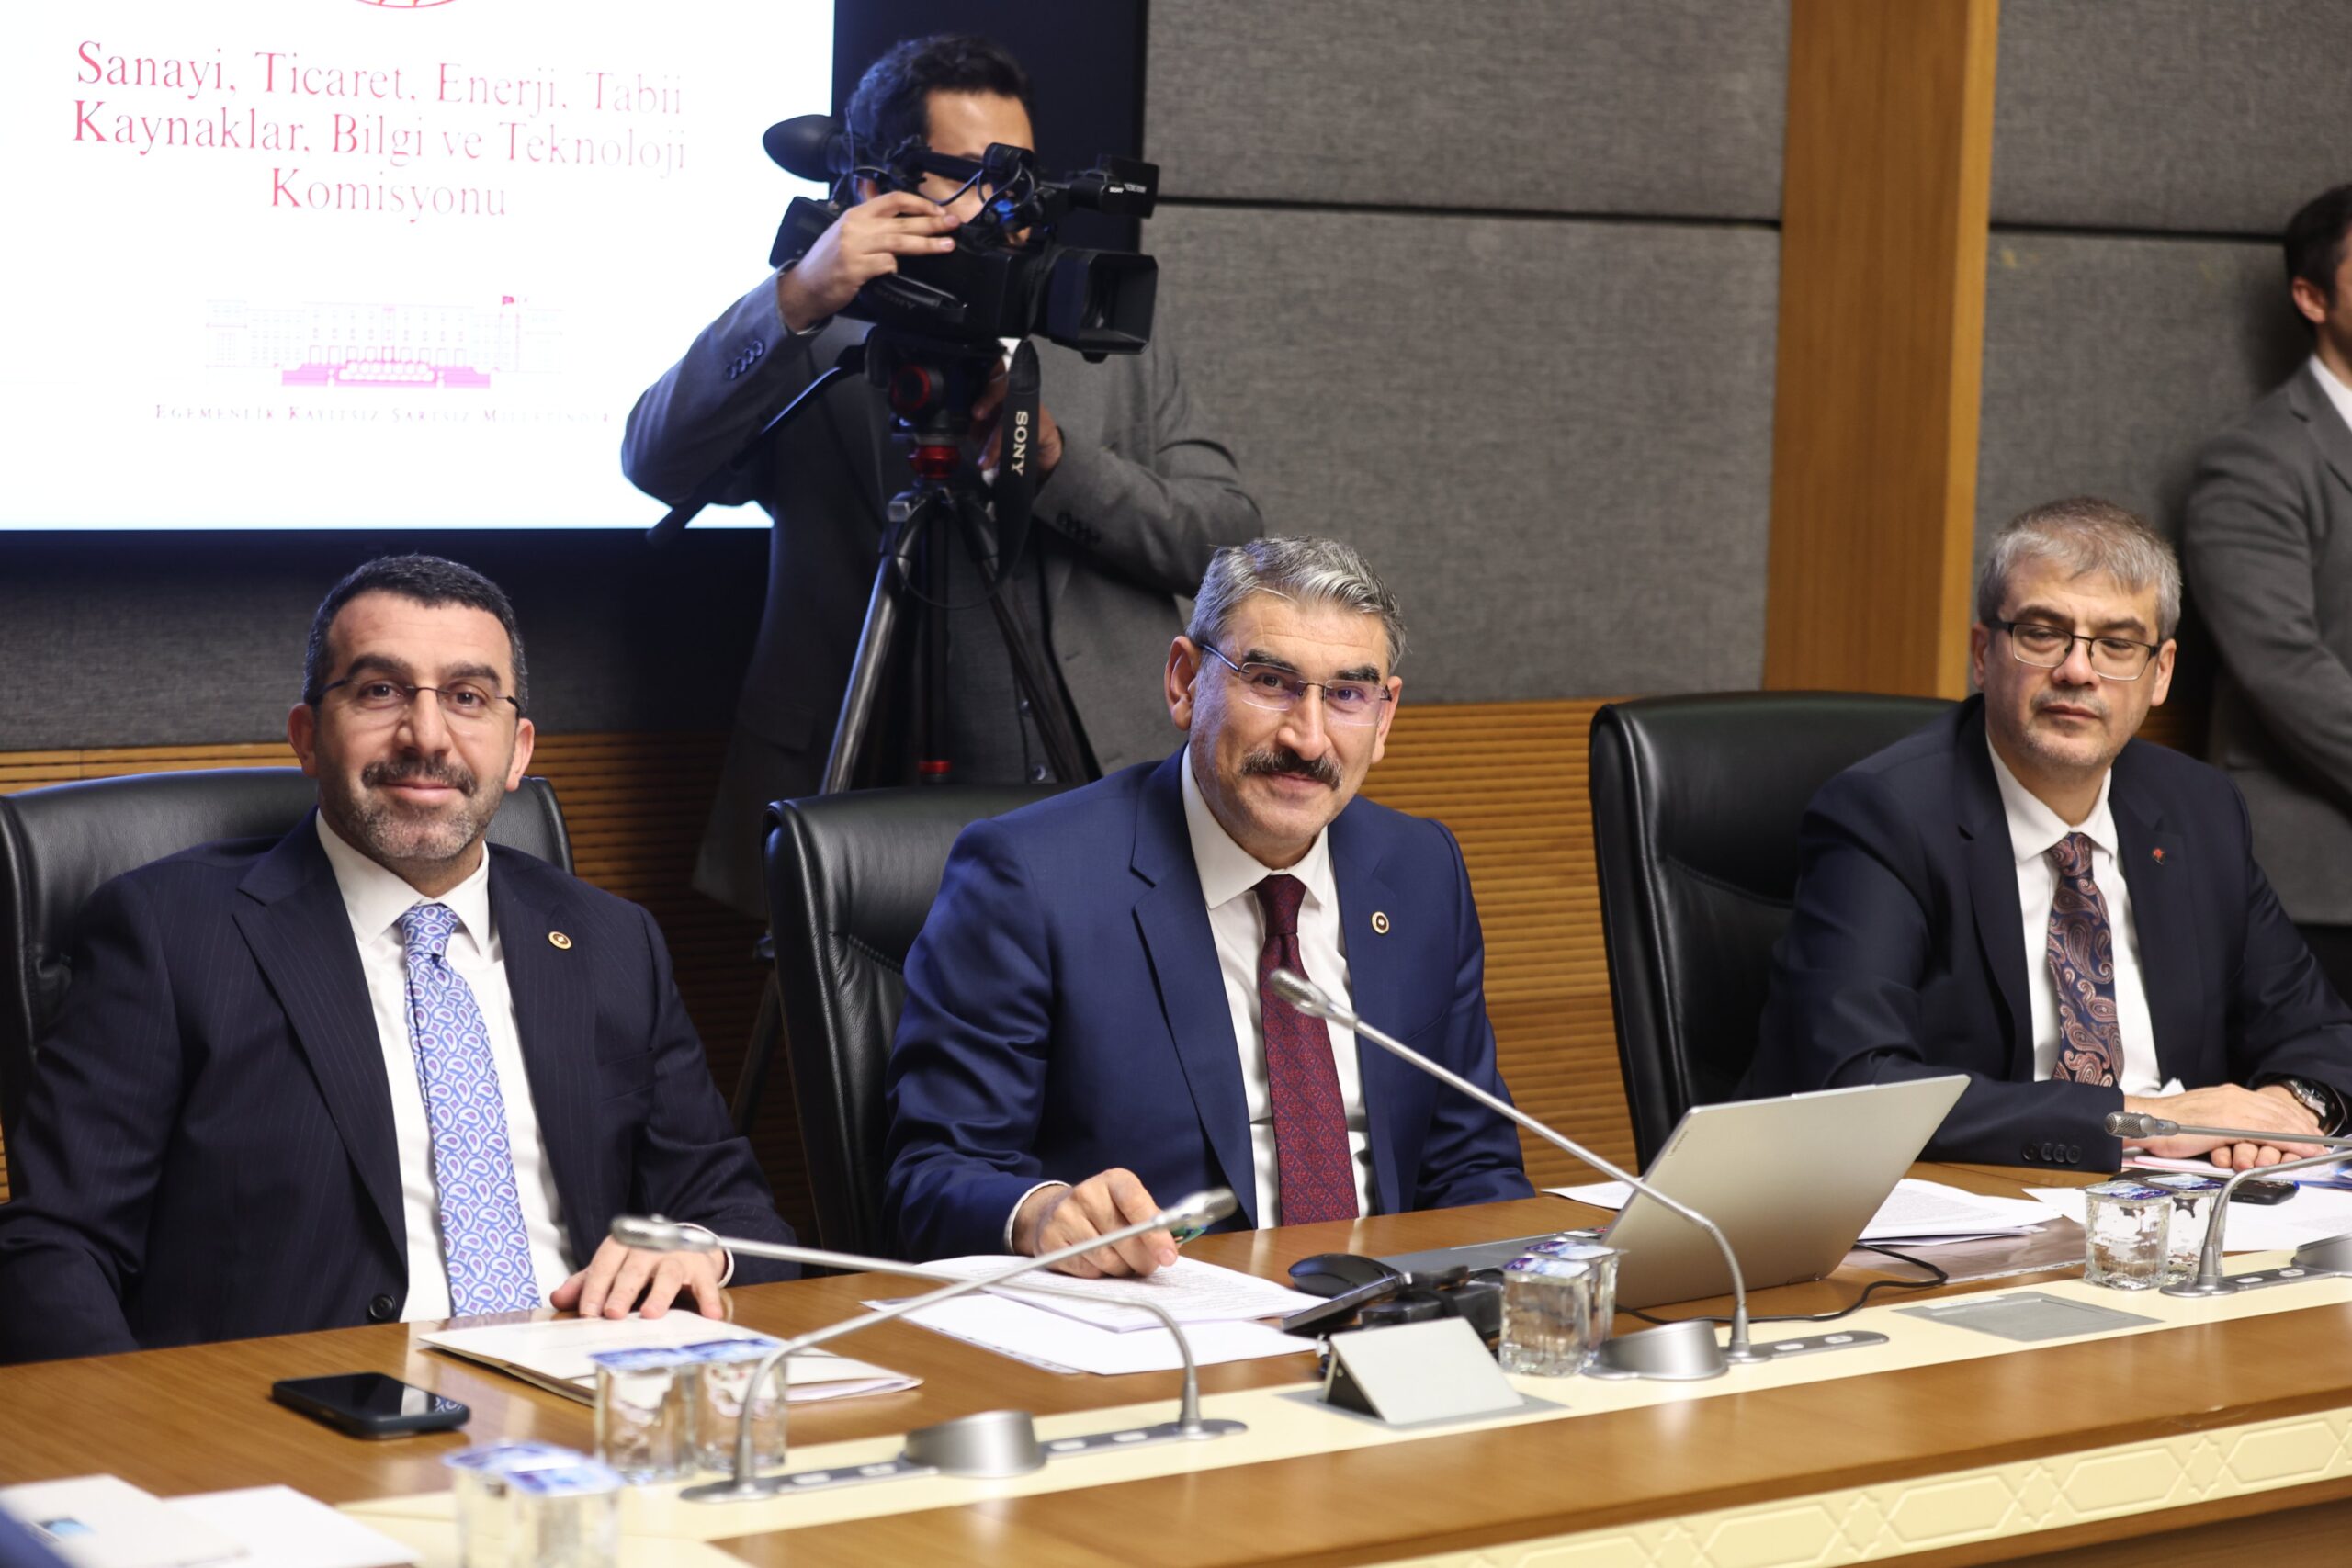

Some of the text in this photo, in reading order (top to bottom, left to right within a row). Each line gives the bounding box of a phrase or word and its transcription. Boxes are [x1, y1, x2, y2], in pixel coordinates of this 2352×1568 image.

[76, 40, 237, 100] Sanayi,
[586, 71, 682, 115] Tabii
[332, 112, 424, 167] Bilgi
[442, 130, 483, 160] ve
[499, 121, 685, 180] Teknoloji
[271, 167, 507, 223] Komisyonu
[1012, 410, 1029, 477] SONY
